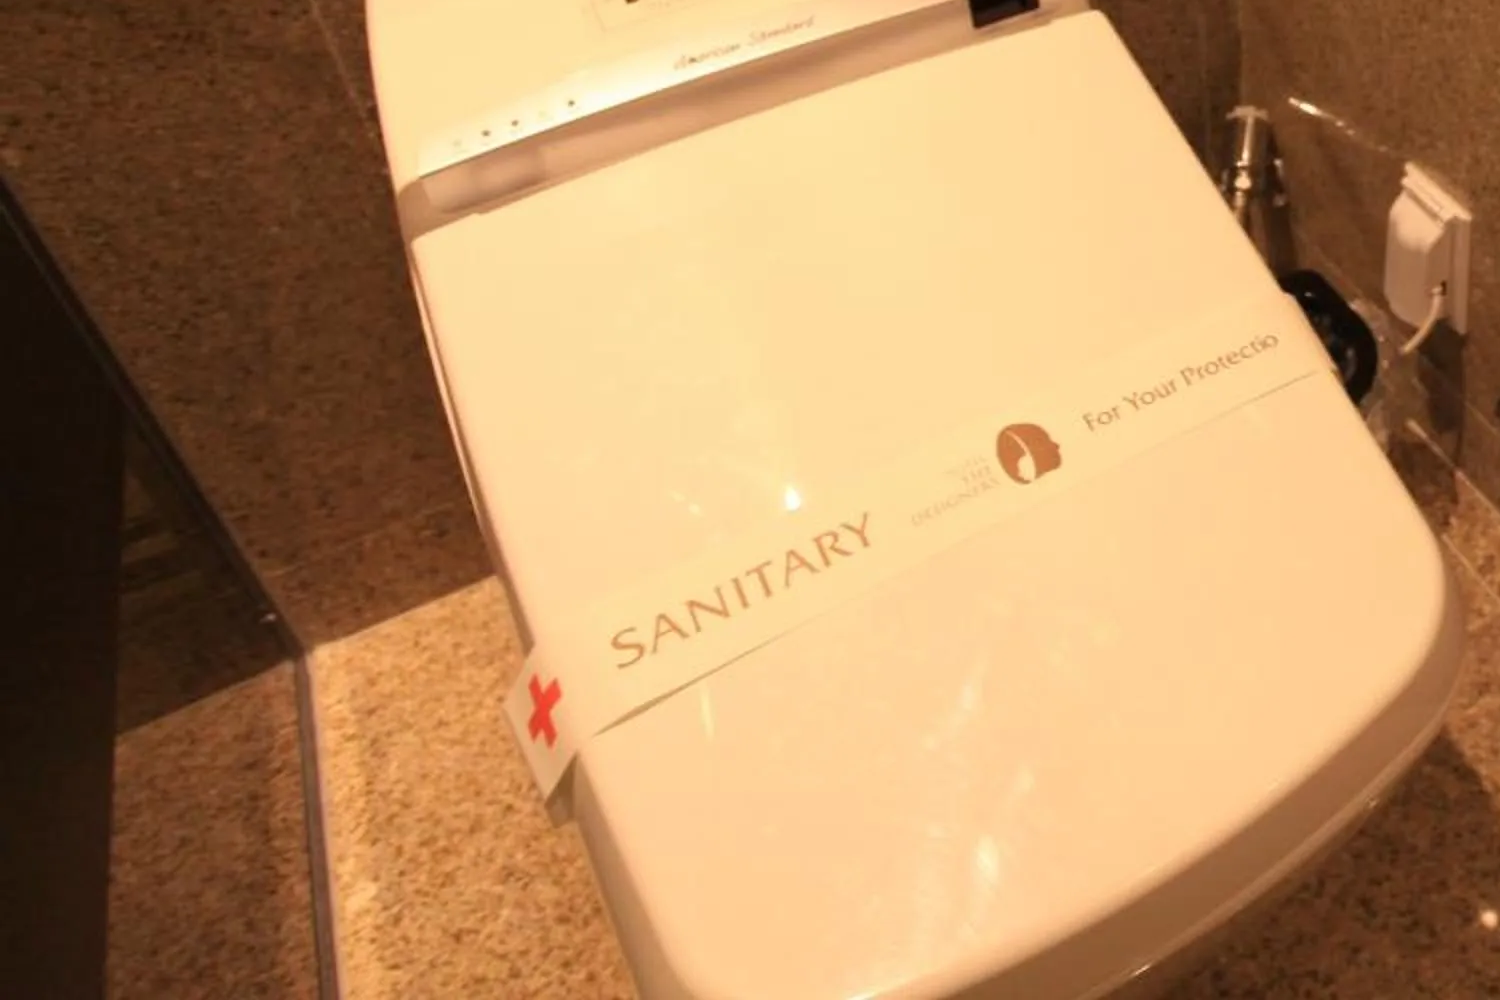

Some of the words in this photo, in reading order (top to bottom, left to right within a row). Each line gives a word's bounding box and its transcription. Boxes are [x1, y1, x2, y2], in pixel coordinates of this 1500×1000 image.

[1082, 406, 1121, 432] For
[1122, 378, 1178, 412] Your
[611, 511, 870, 669] SANITARY
